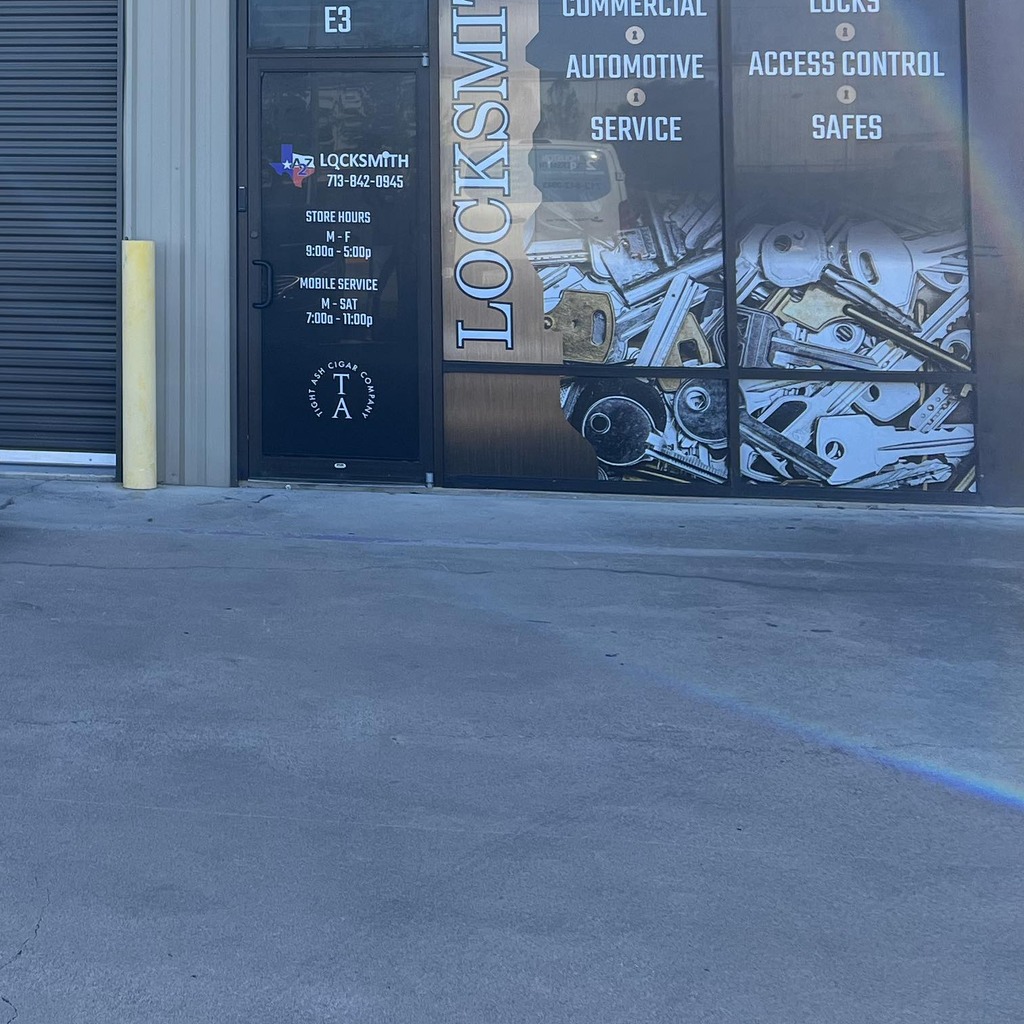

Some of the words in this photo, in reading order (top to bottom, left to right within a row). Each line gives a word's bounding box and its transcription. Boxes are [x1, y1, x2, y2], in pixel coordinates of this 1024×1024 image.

[324, 5, 351, 33] E3
[566, 54, 705, 79] AUTOMOTIVE
[748, 51, 835, 76] ACCESS
[841, 51, 945, 77] CONTROL
[590, 116, 683, 141] SERVICE
[812, 114, 882, 140] SAFES
[326, 173, 404, 188] 713-842-0945
[305, 210, 336, 223] STORE
[338, 211, 371, 224] HOURS
[326, 230, 335, 243] M
[344, 231, 351, 243] F
[305, 244, 334, 257] 9:00a
[343, 245, 372, 260] 5:00p
[300, 277, 336, 290] MOBILE
[338, 278, 378, 291] SERVICE
[321, 297, 330, 310] M
[339, 298, 358, 310] SAT
[306, 311, 334, 325] 7:00a
[342, 312, 373, 328] 11:00p
[327, 360, 358, 372] CIGAR
[311, 367, 326, 386] ASH
[332, 373, 350, 395] T
[308, 388, 323, 418] TIGHT
[360, 371, 376, 419] COMPANY
[331, 397, 353, 419] A
